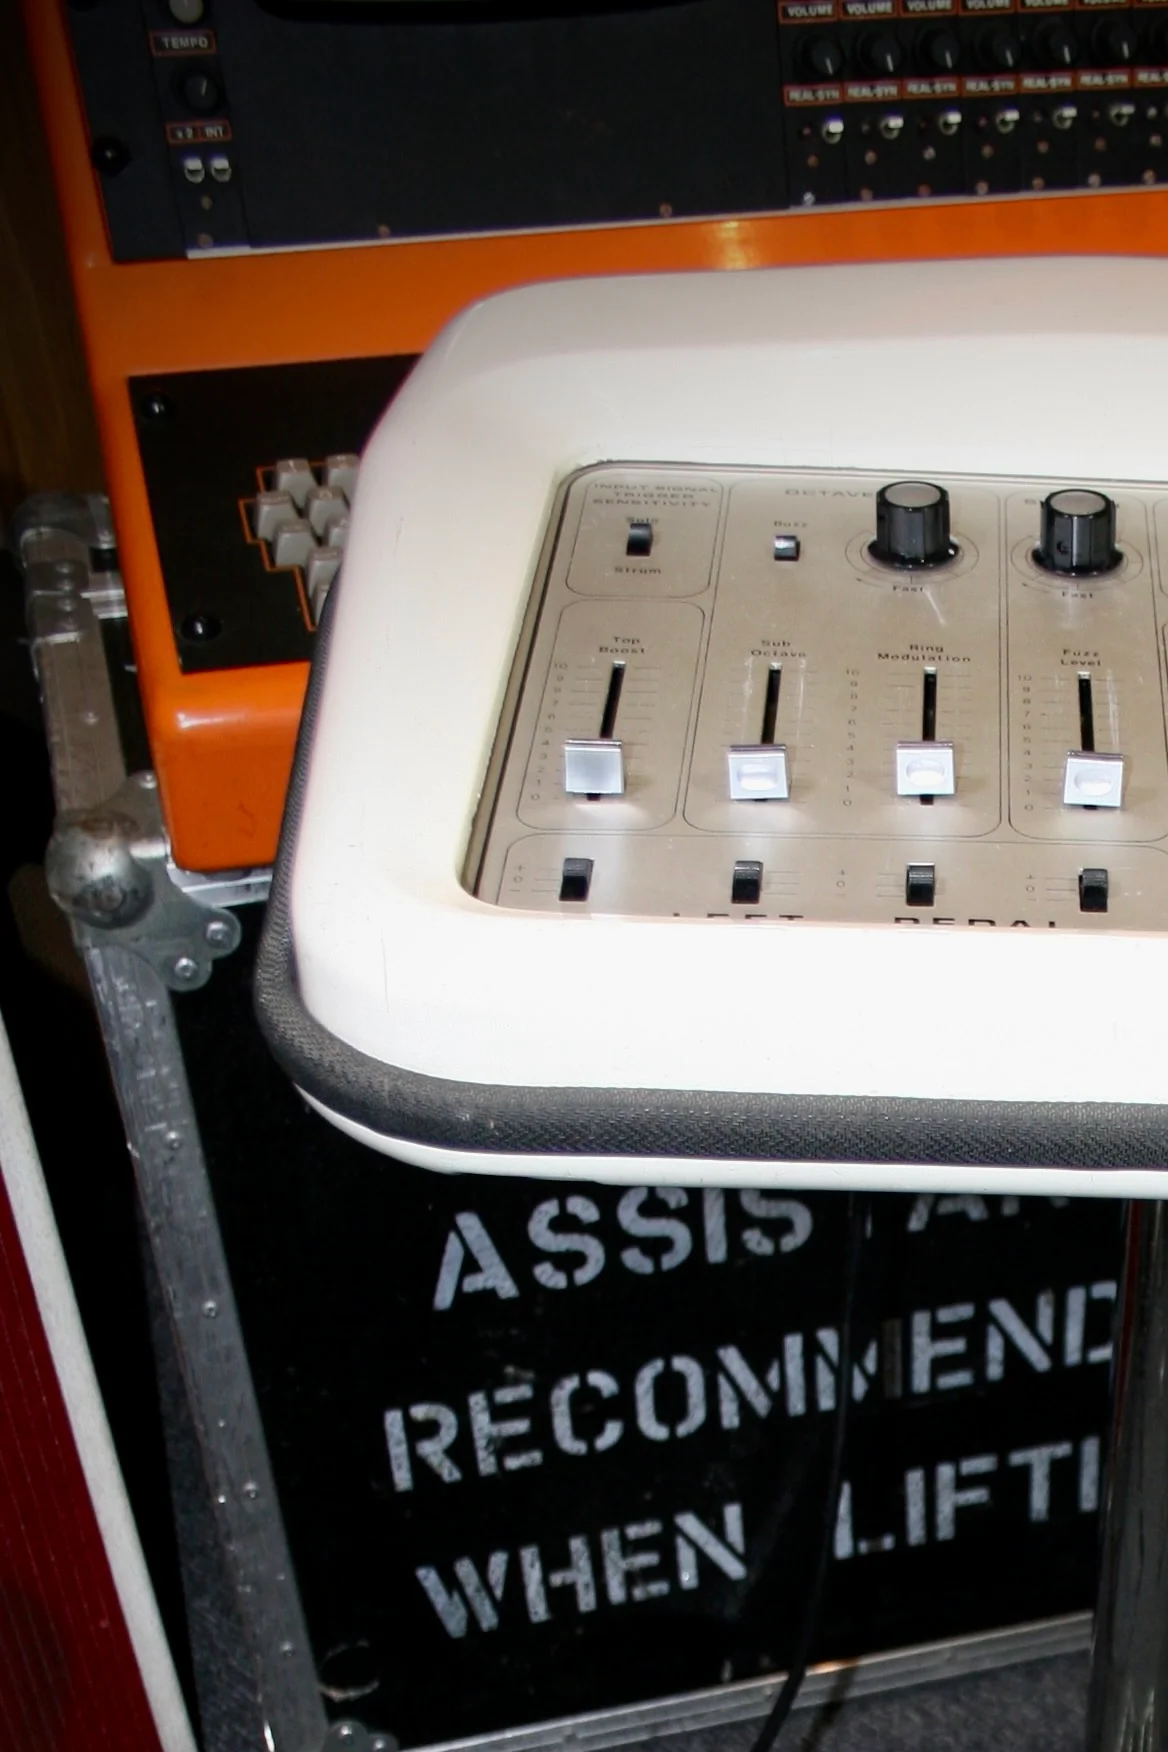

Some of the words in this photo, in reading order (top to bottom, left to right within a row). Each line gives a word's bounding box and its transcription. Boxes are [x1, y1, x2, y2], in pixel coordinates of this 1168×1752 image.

[787, 4, 833, 17] VOLUME
[847, 1, 893, 15] VOLUME
[163, 36, 208, 49] TEMPO
[615, 491, 694, 499] TRIGGER
[785, 488, 874, 498] OCTAVE
[593, 498, 711, 508] SENSITIVITY
[773, 520, 808, 528] Buzz
[614, 566, 662, 575] Strum
[893, 585, 924, 593] Fast
[1061, 590, 1093, 599] Fast
[613, 636, 641, 646] Top
[761, 638, 791, 648] Sub
[598, 646, 646, 655] Boost
[750, 648, 808, 659] Octave
[909, 644, 945, 655] Ring
[1062, 649, 1099, 658] Fuzz
[877, 652, 972, 664] Modulation
[1060, 658, 1101, 667] Level
[433, 1186, 850, 1311] ASSIS
[415, 1503, 748, 1639] WHEN
